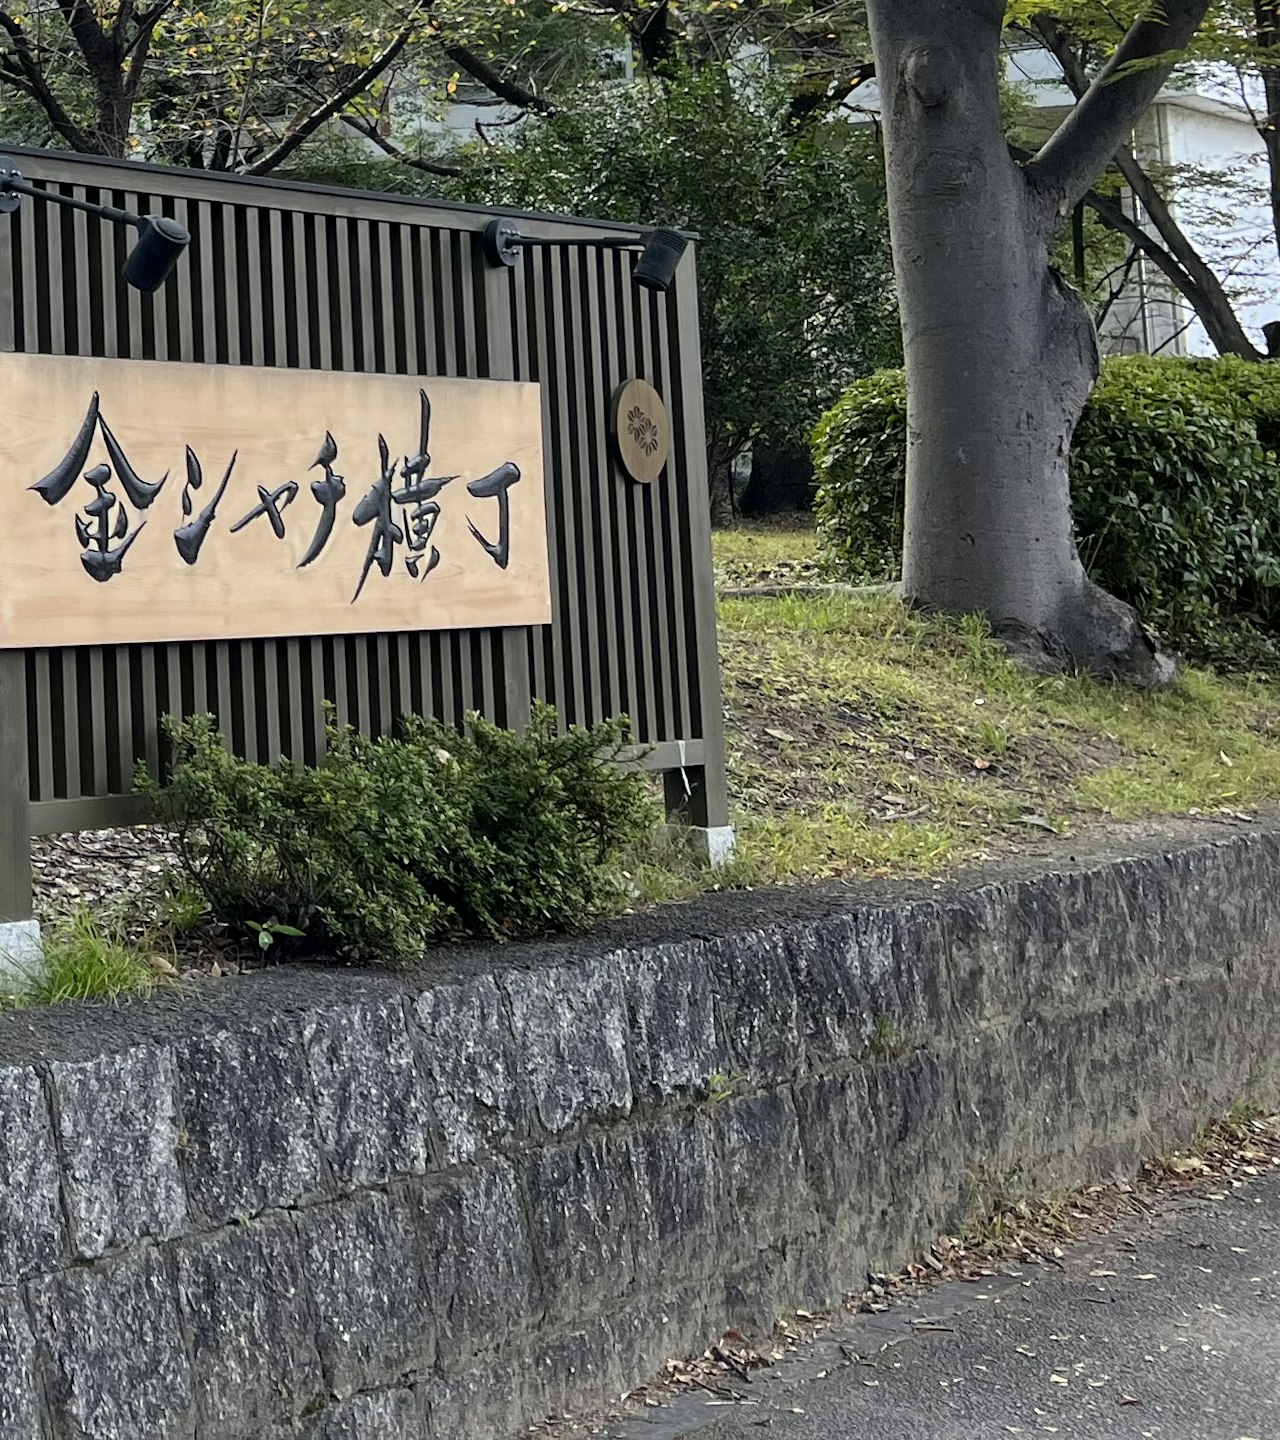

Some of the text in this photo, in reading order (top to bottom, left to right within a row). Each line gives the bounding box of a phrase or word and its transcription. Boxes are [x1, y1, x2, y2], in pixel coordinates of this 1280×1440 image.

[26, 389, 520, 604] 金シャチ横丁
